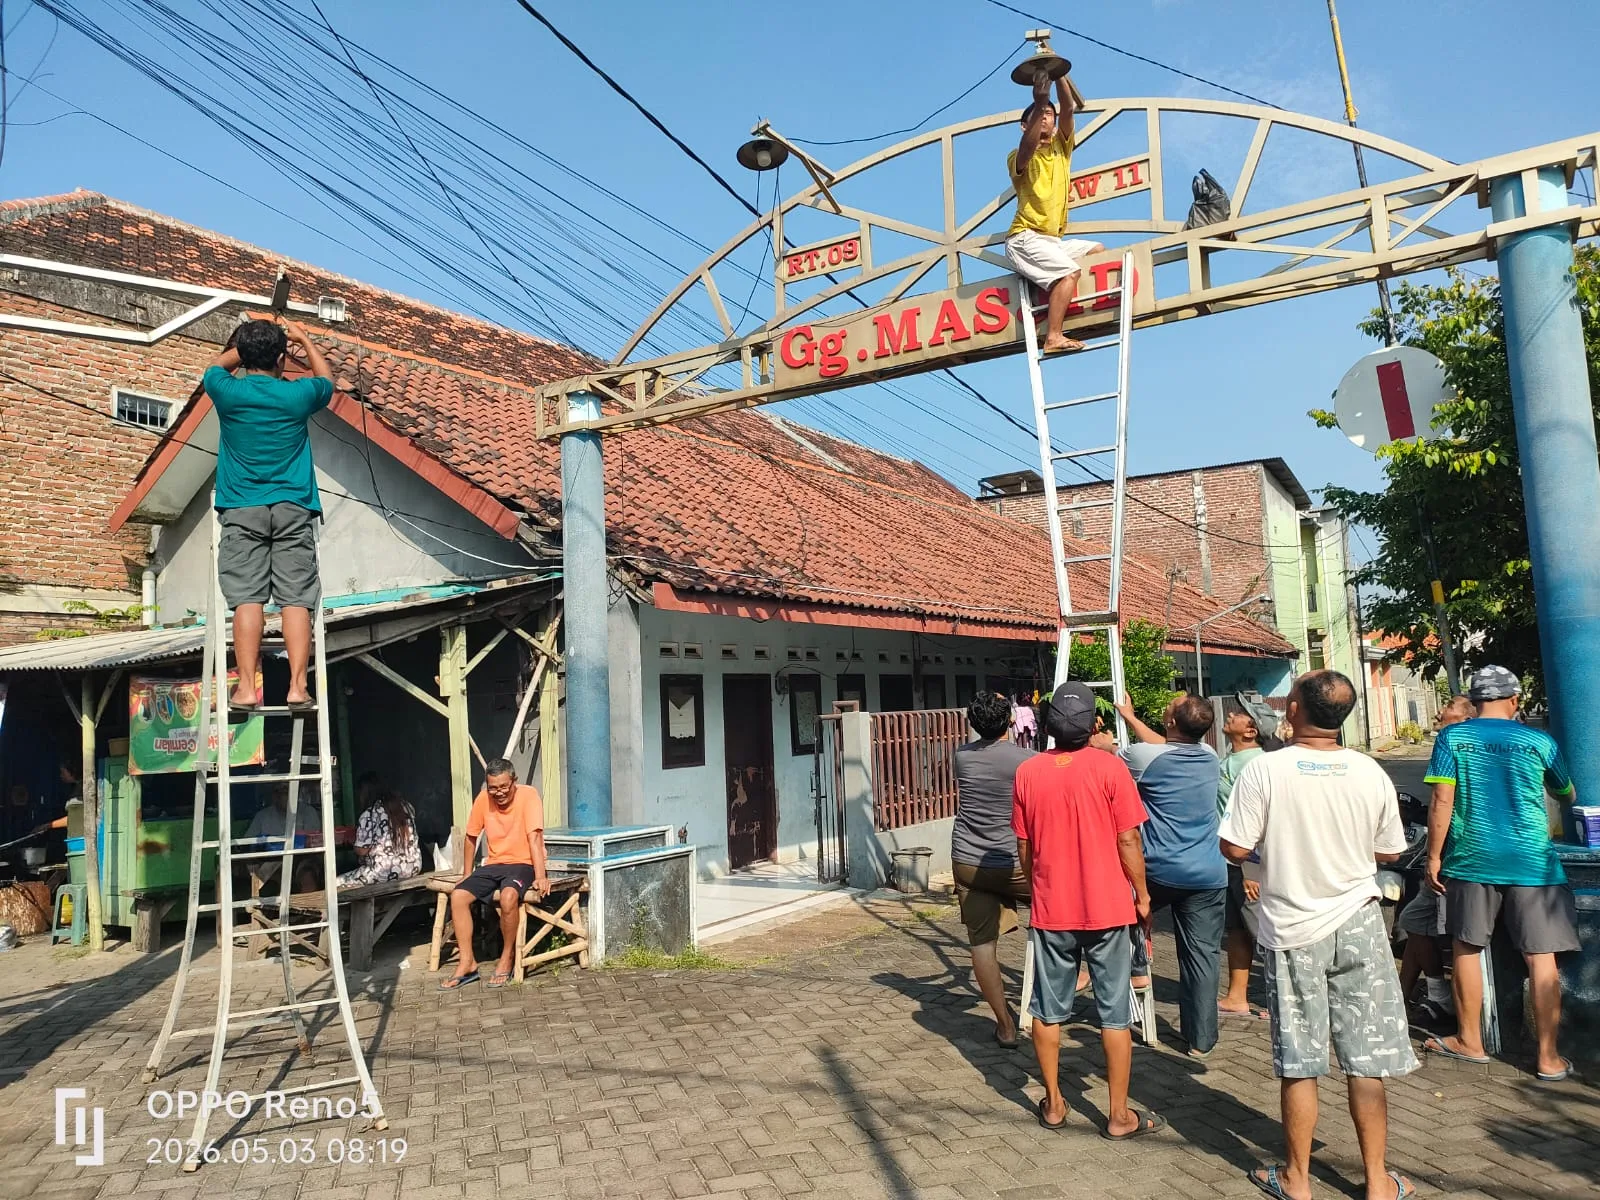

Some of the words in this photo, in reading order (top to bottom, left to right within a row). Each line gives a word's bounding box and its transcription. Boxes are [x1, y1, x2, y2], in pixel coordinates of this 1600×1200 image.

[1113, 163, 1143, 191] 11
[786, 239, 859, 276] RT.09
[154, 738, 197, 754] Cemilan
[1484, 743, 1539, 756] WIJAYA
